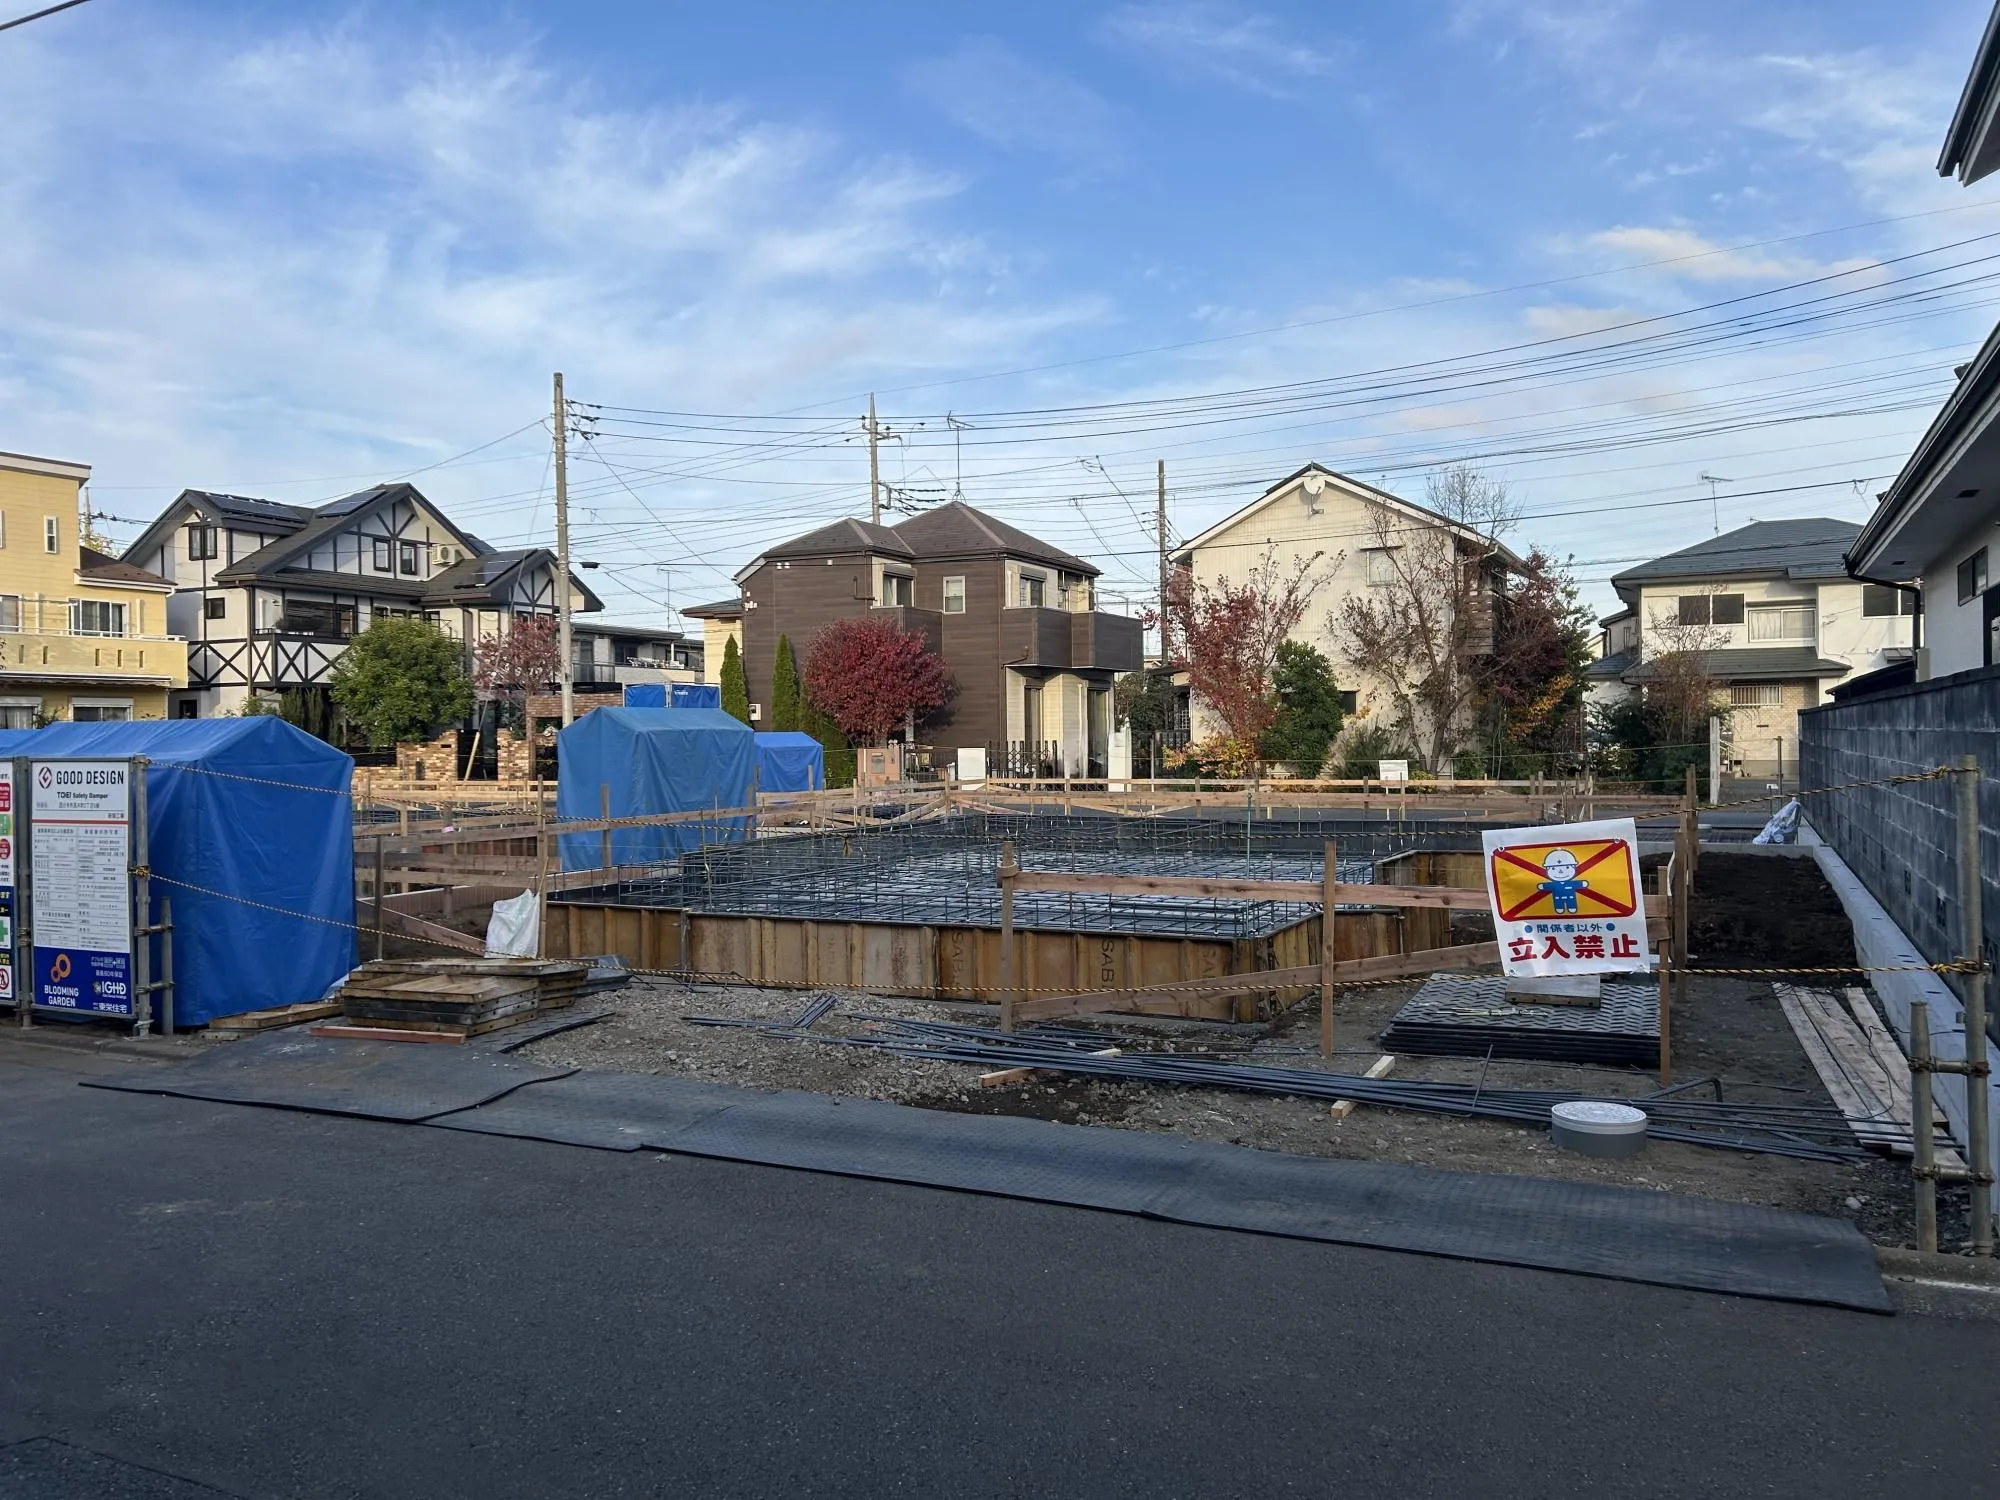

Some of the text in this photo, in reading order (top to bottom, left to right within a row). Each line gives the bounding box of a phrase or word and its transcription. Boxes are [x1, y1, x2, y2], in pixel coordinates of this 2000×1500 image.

[56, 770, 124, 785] GOOD DESIGN
[1536, 922, 1603, 934] 関係者以外
[1507, 933, 1641, 963] 立入禁止
[44, 985, 79, 997] BLOOMING
[48, 996, 76, 1007] GARDEN
